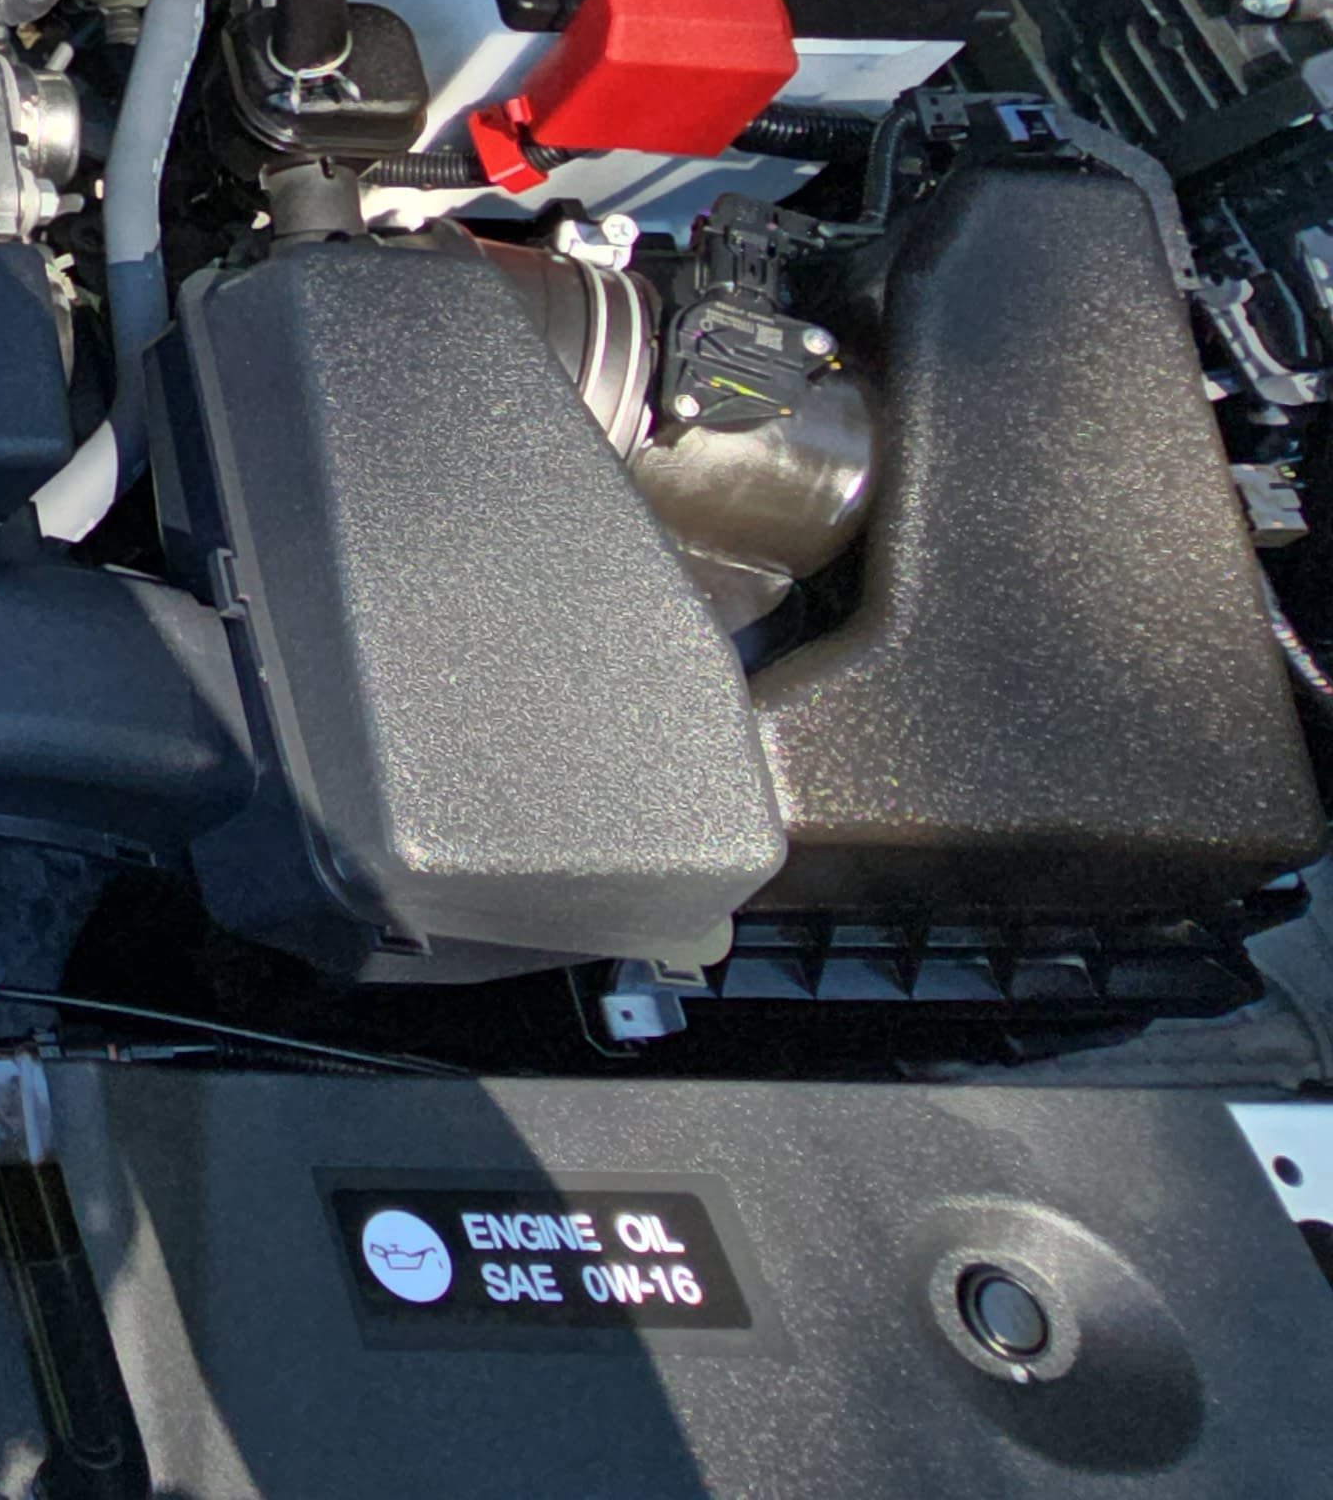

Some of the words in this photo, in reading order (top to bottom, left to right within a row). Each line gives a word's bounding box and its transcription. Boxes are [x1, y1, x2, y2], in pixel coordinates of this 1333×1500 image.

[461, 1212, 602, 1252] ENGINE
[615, 1214, 685, 1253] OIL
[481, 1262, 563, 1302] SAE
[582, 1264, 703, 1306] 0W-16
